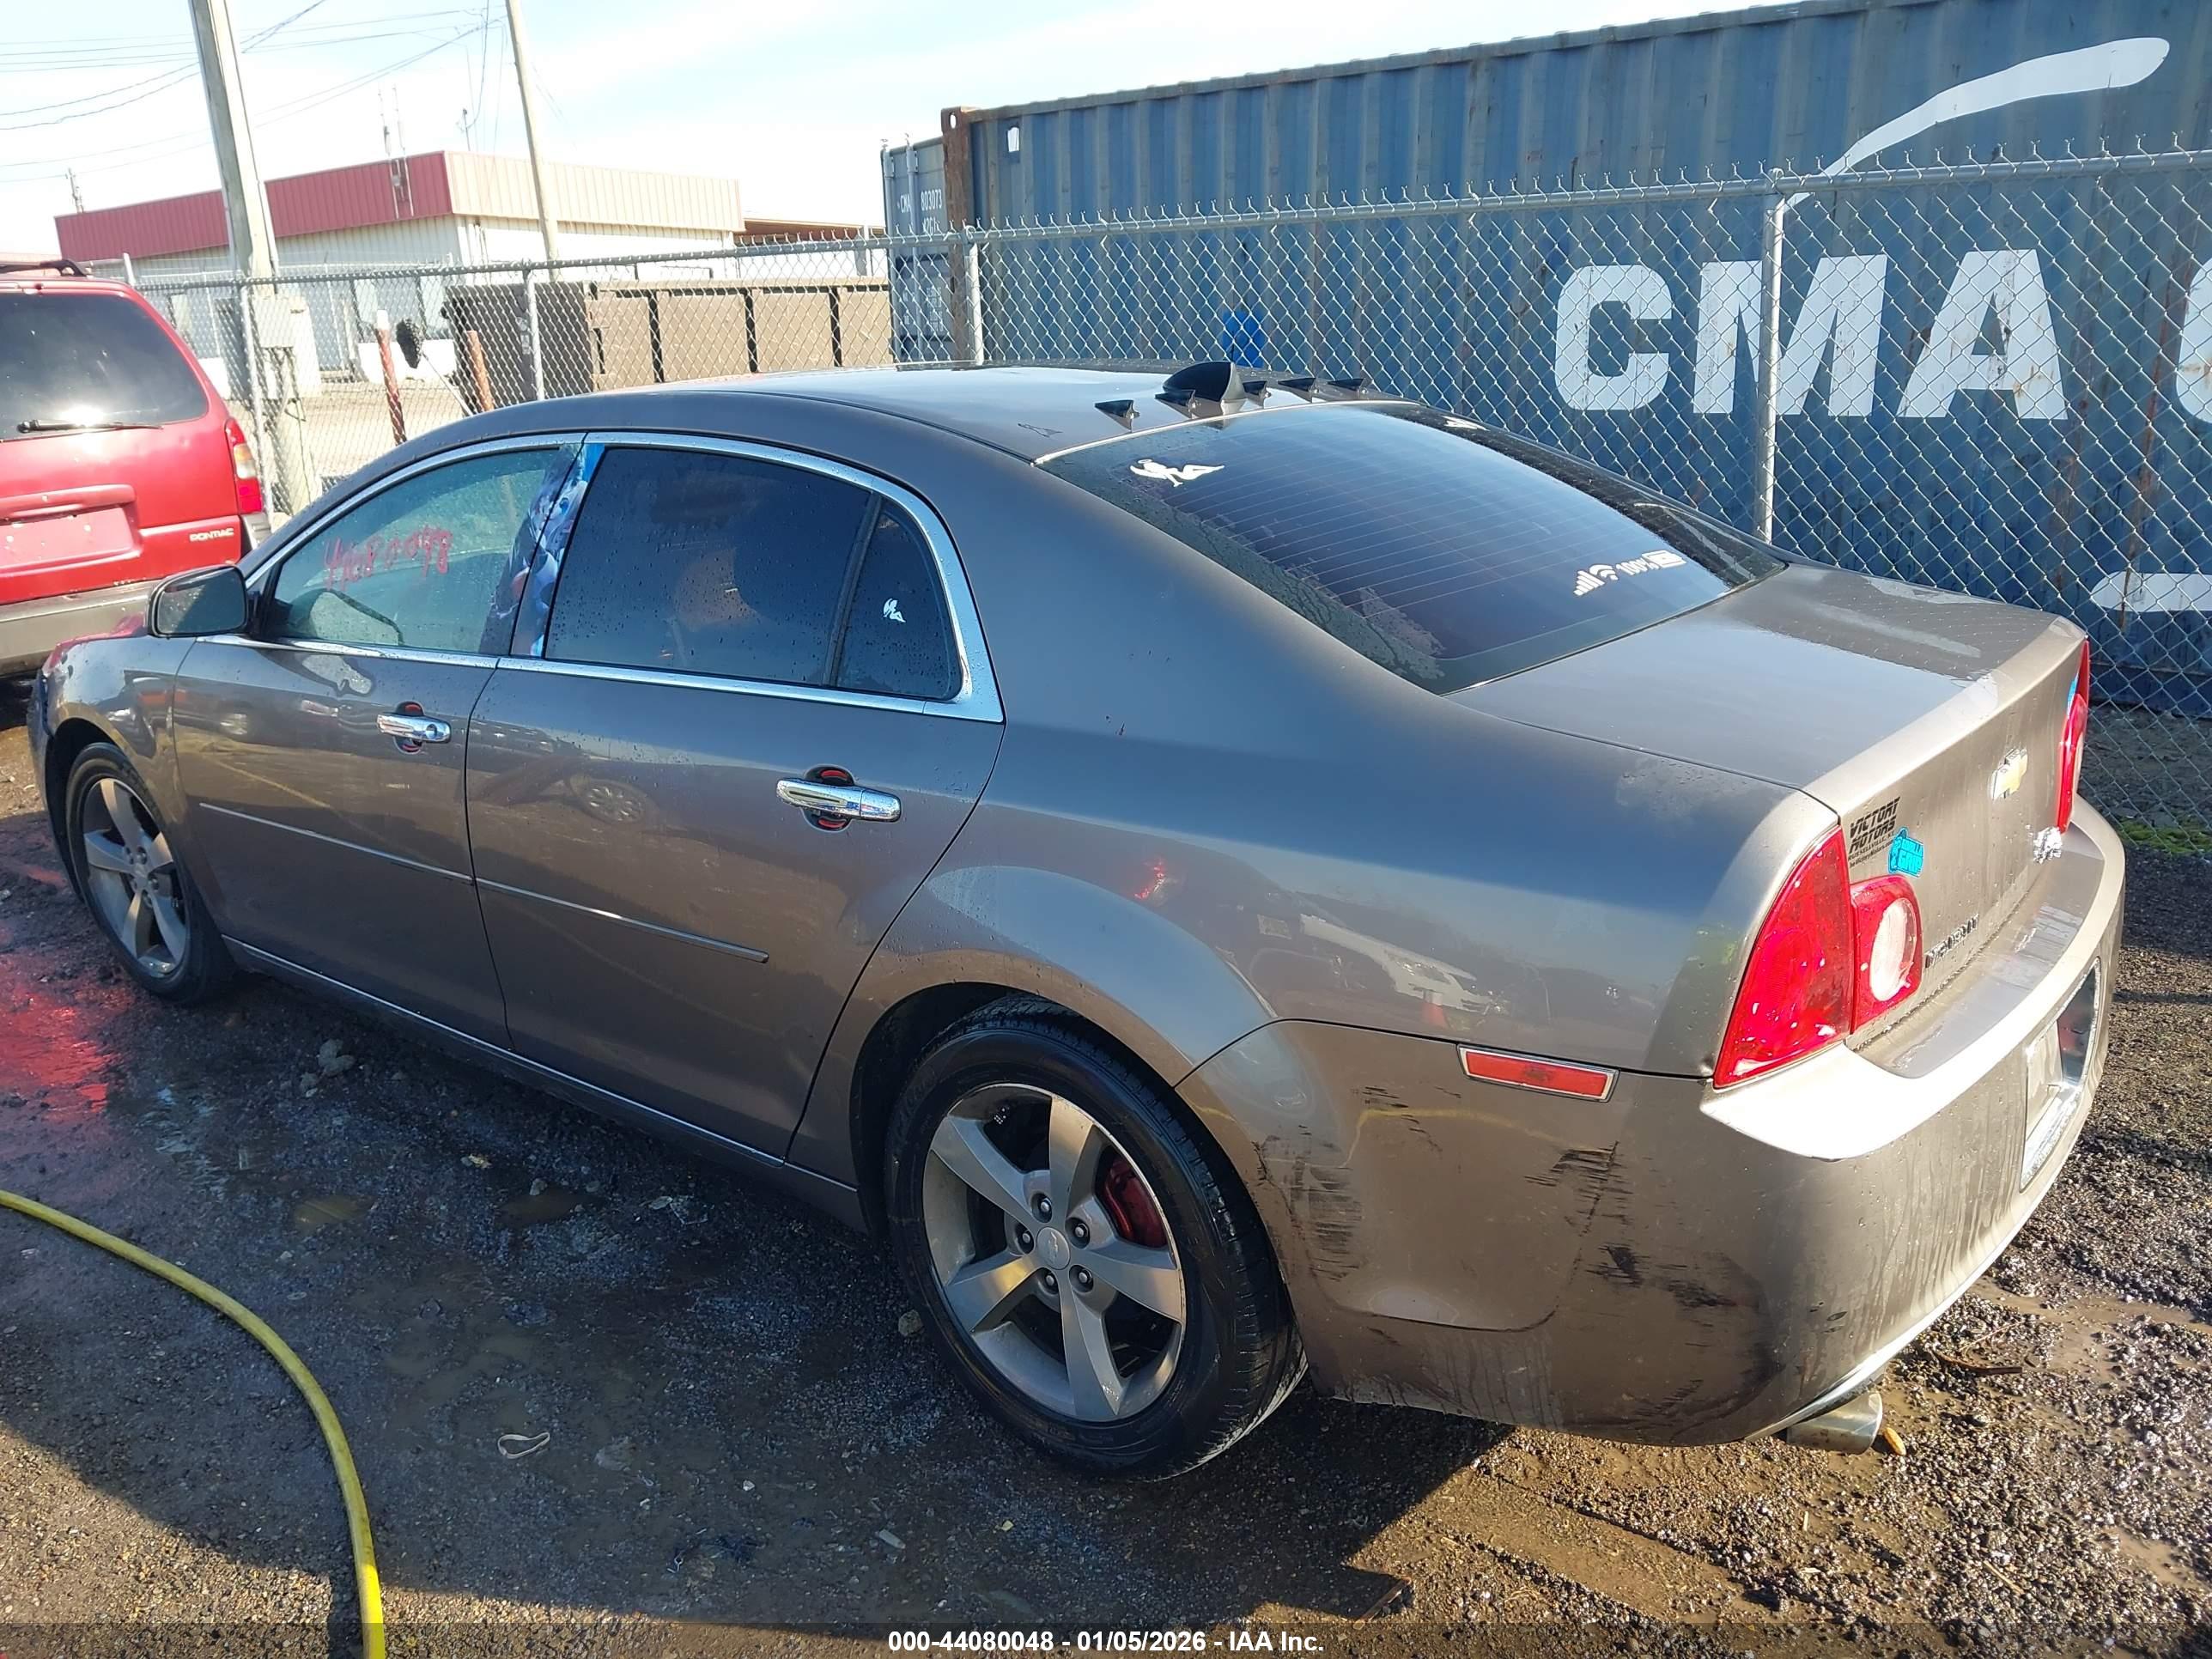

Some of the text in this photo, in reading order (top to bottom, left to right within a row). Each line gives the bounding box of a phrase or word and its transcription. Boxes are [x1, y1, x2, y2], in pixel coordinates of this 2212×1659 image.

[921, 188, 942, 211] 803073
[1554, 249, 2068, 421] CMA
[190, 527, 234, 542] PONTIAC
[1849, 814, 1896, 854] MOTORS
[1850, 796, 1900, 839] VICTORY
